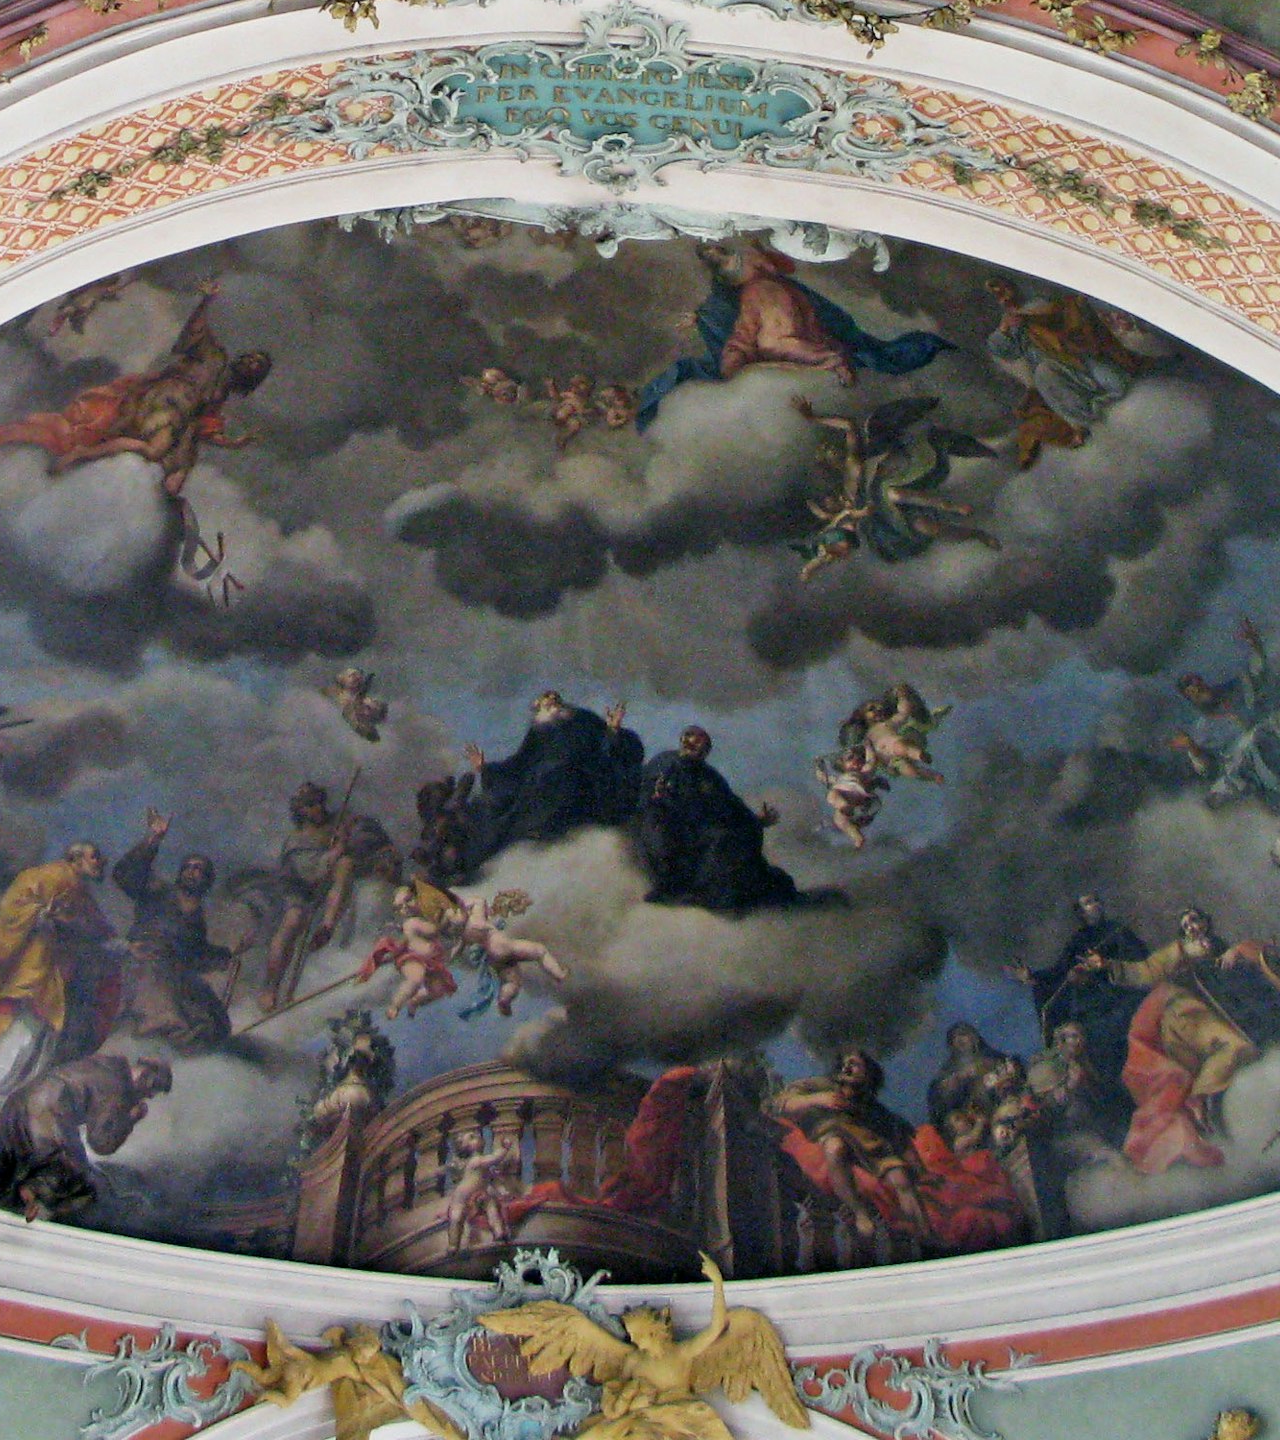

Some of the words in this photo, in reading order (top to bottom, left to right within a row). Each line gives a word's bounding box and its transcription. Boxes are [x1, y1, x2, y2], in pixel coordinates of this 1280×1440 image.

[499, 63, 530, 79] IN
[476, 85, 539, 104] PER
[552, 85, 768, 120] EVANGELIUM
[506, 106, 571, 126] EGO
[581, 108, 640, 128] VOS
[648, 113, 743, 139] GENUI
